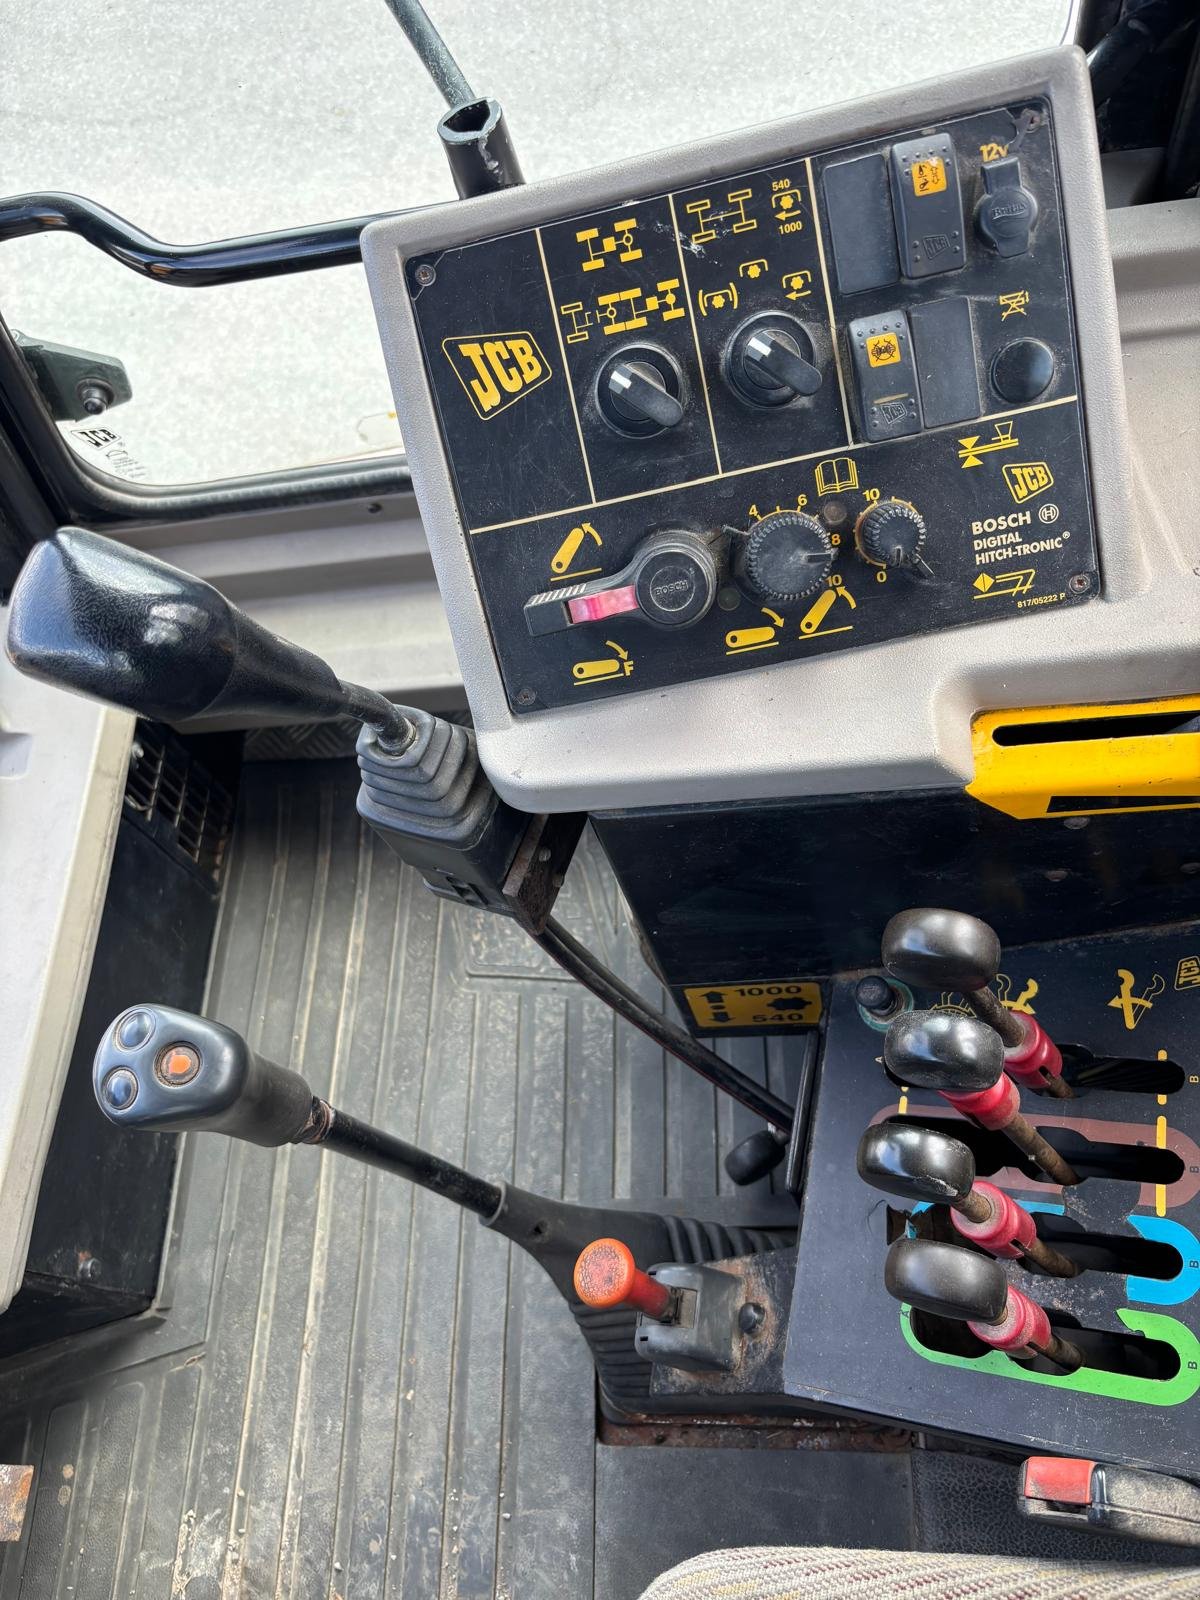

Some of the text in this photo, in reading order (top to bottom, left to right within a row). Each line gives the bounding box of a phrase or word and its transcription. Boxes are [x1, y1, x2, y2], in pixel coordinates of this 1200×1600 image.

[772, 178, 791, 191] 540
[779, 221, 803, 234] 1000
[458, 339, 543, 413] JCB
[78, 429, 117, 447] JCB
[1011, 466, 1049, 499] JCB
[798, 494, 808, 506] 6
[863, 488, 881, 502] 10
[749, 504, 758, 516] 4
[971, 511, 1032, 535] BOSCH
[831, 534, 841, 545] 8
[973, 531, 1023, 551] DIGITAL
[826, 574, 843, 587] 10
[876, 571, 887, 583] 0
[654, 580, 689, 595] BOSCH
[1017, 594, 1058, 608] 817/05222
[1178, 959, 1200, 986] JCB
[735, 985, 802, 997] 1000
[752, 1013, 804, 1022] 540
[1190, 1075, 1199, 1083] B
[1190, 1259, 1199, 1268] B
[1187, 1360, 1198, 1370] B
